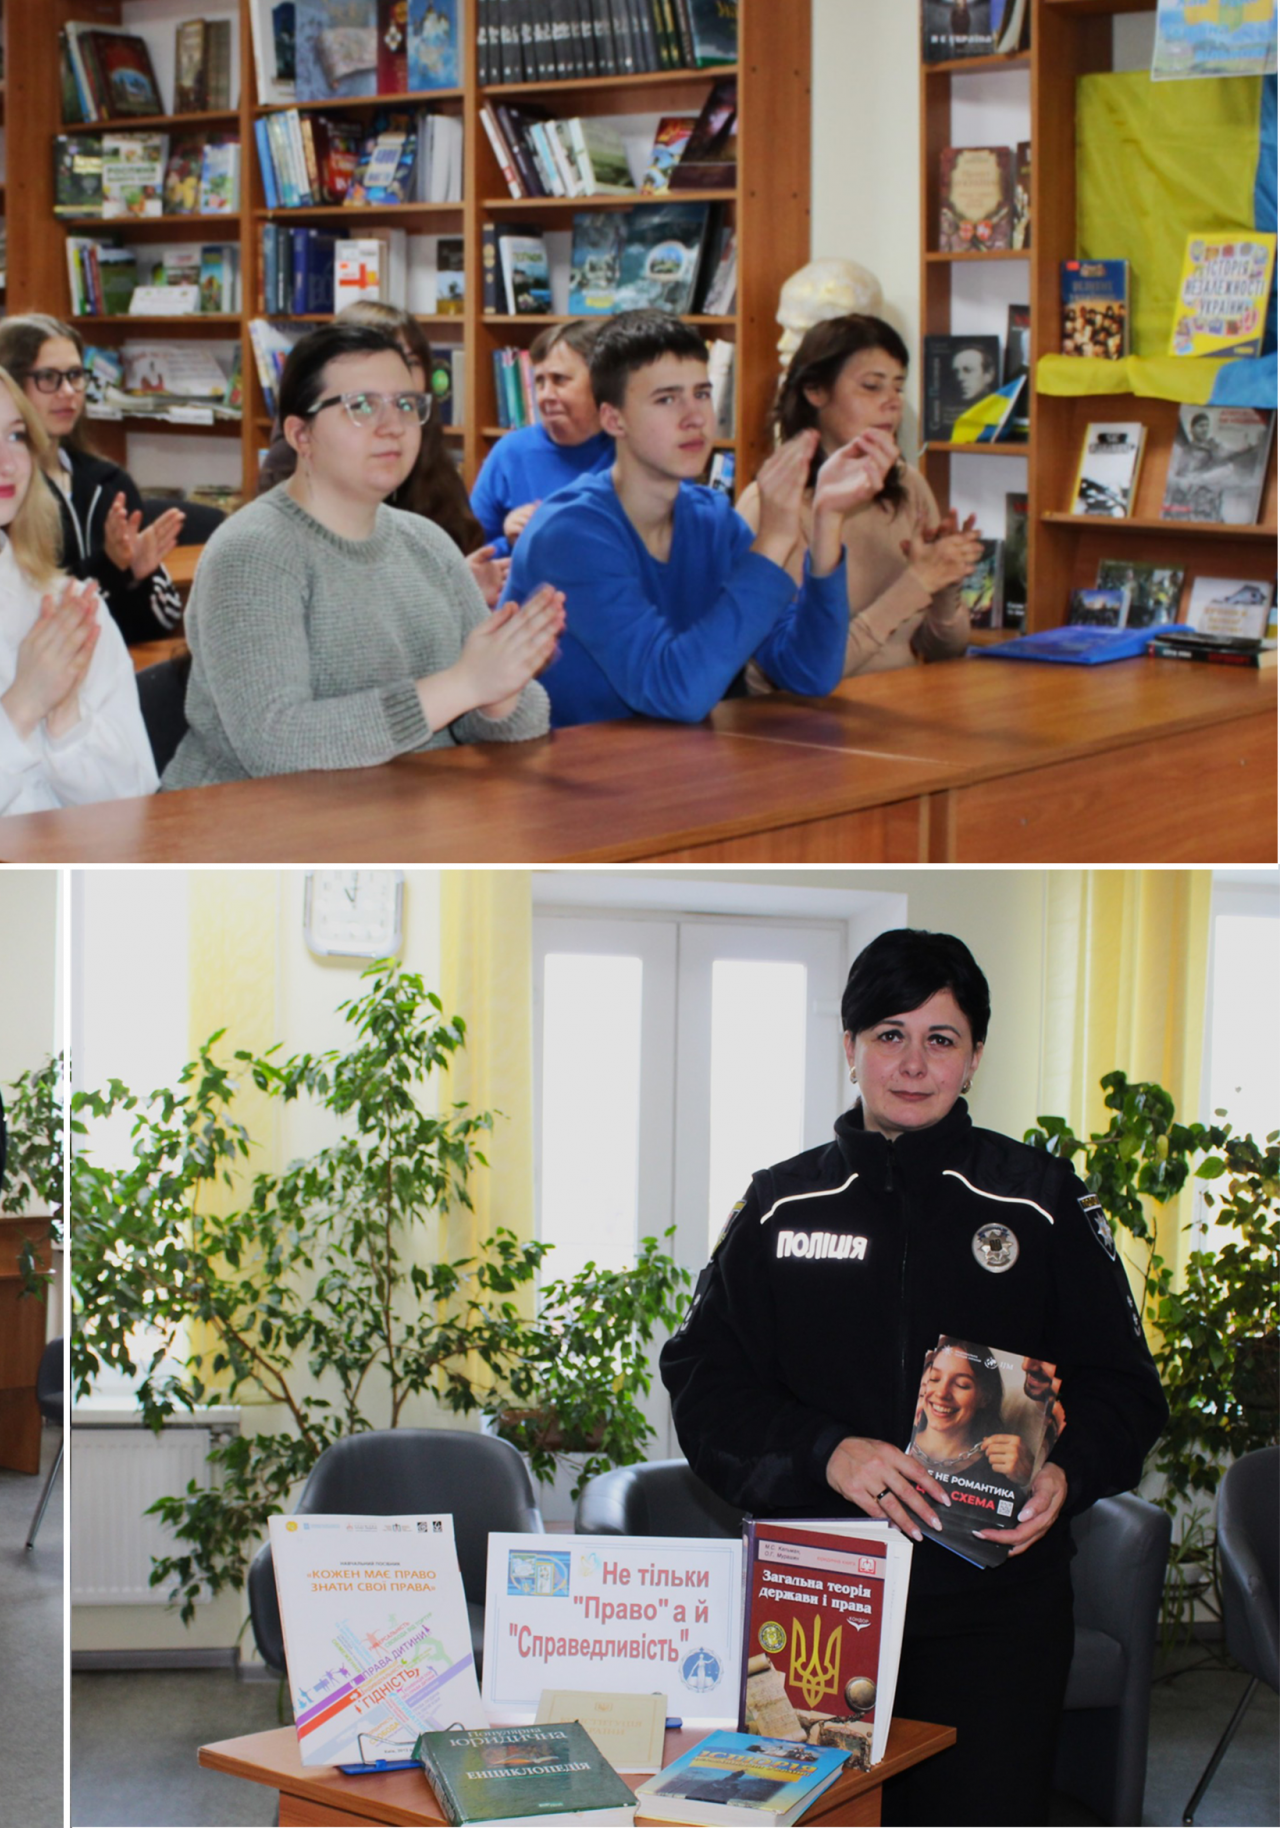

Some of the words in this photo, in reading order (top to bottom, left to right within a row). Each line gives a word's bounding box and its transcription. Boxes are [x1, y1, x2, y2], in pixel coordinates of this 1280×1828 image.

[1205, 261, 1251, 277] ІСТОРІЯ
[1184, 279, 1266, 296] НЕЗАЛЕЖНОСТІ
[1199, 299, 1246, 316] УКРАЇНИ
[777, 1230, 868, 1260] ПОЛІЦІЯ
[934, 1471, 949, 1483] НЕ
[951, 1475, 1015, 1499] РОМАНТИКА
[950, 1490, 995, 1511] СХЕМА
[307, 1569, 361, 1579] «КОЖЕН
[364, 1569, 391, 1579] МАЄ
[395, 1570, 437, 1579] ПРАВО
[311, 1582, 354, 1592] ЗНАТИ
[357, 1580, 387, 1592] СВОЇ
[390, 1583, 436, 1592] ПРАВА»
[602, 1561, 631, 1586] Не
[638, 1563, 709, 1588] тільки
[762, 1569, 823, 1590] Загальна
[827, 1582, 871, 1599] теорія
[573, 1595, 669, 1625] "Право"
[673, 1603, 686, 1623] а
[694, 1598, 709, 1623] й
[758, 1586, 819, 1605] держави
[822, 1594, 827, 1606] і
[831, 1598, 872, 1614] права
[361, 1653, 392, 1679] ПРАВА
[390, 1629, 427, 1659] ДИТИНИ
[509, 1622, 689, 1665] "Справедливість"
[361, 1664, 417, 1710] ГІДНІСТЬ
[467, 1727, 542, 1737] Популярна
[466, 1761, 591, 1780] ЕНЦИКЛОПЕДІЯ
